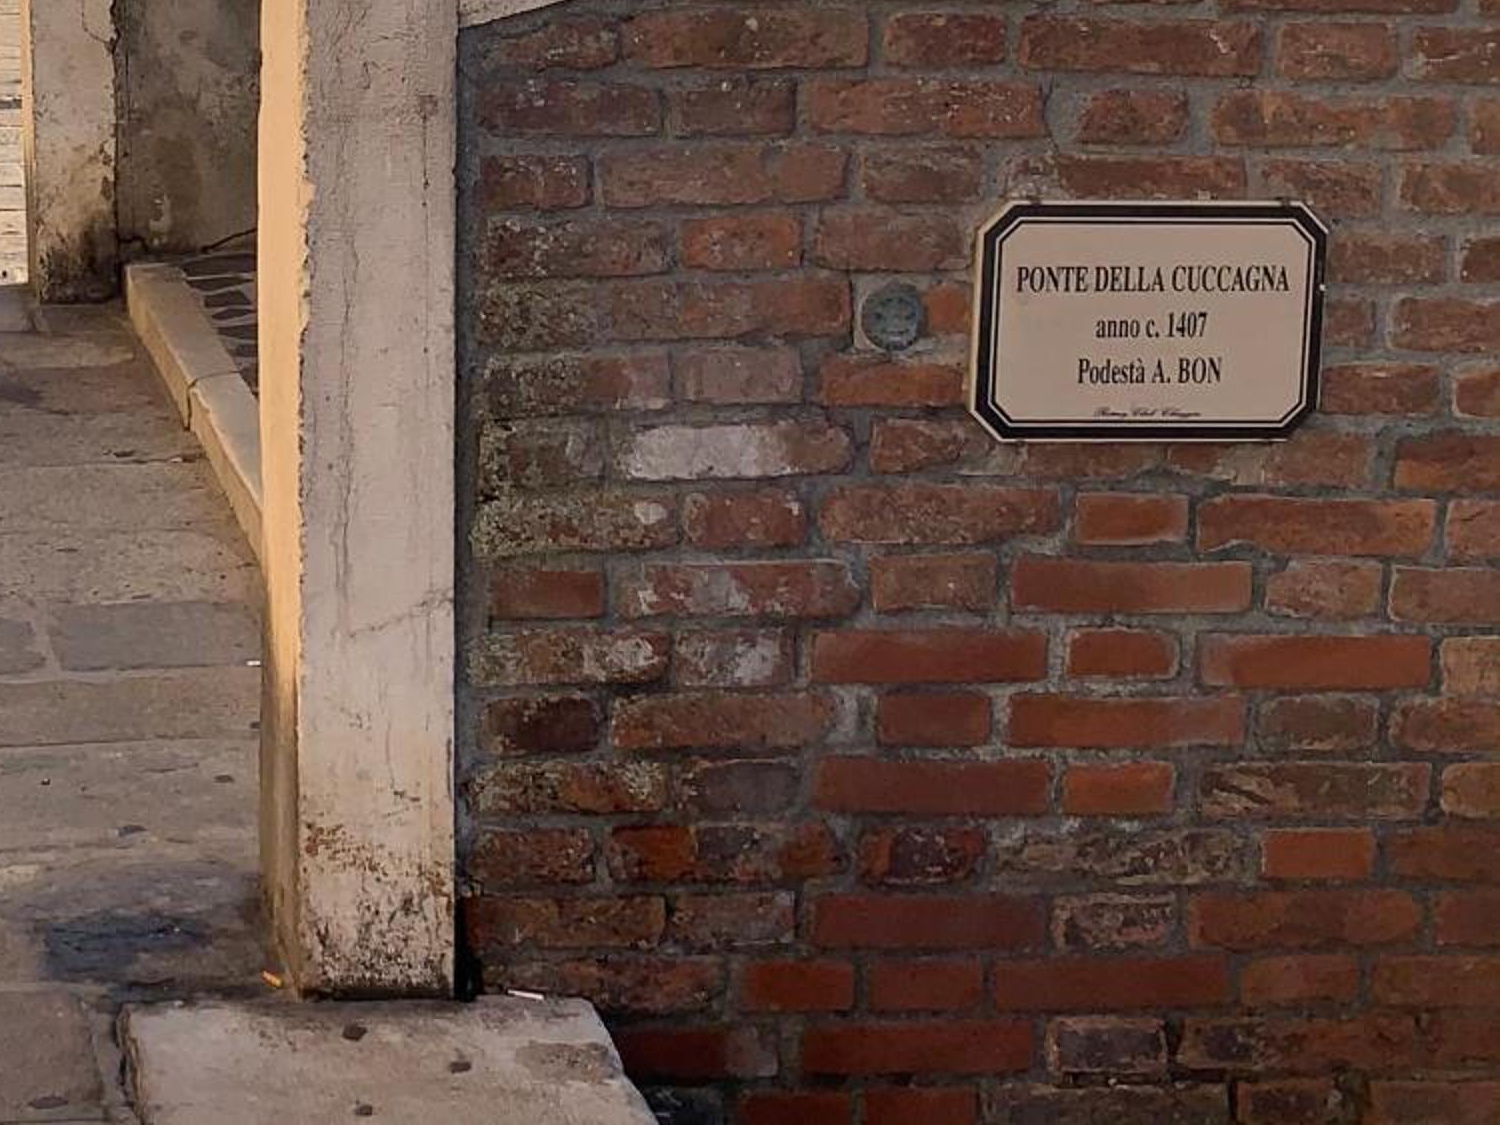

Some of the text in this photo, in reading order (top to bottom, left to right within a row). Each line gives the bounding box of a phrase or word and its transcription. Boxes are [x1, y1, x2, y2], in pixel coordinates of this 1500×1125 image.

[1016, 265, 1290, 293] PONTE DELLA CUCCAGNA
[1095, 311, 1208, 338] anno c. 1407
[1077, 357, 1223, 384] Podestà A. BON
